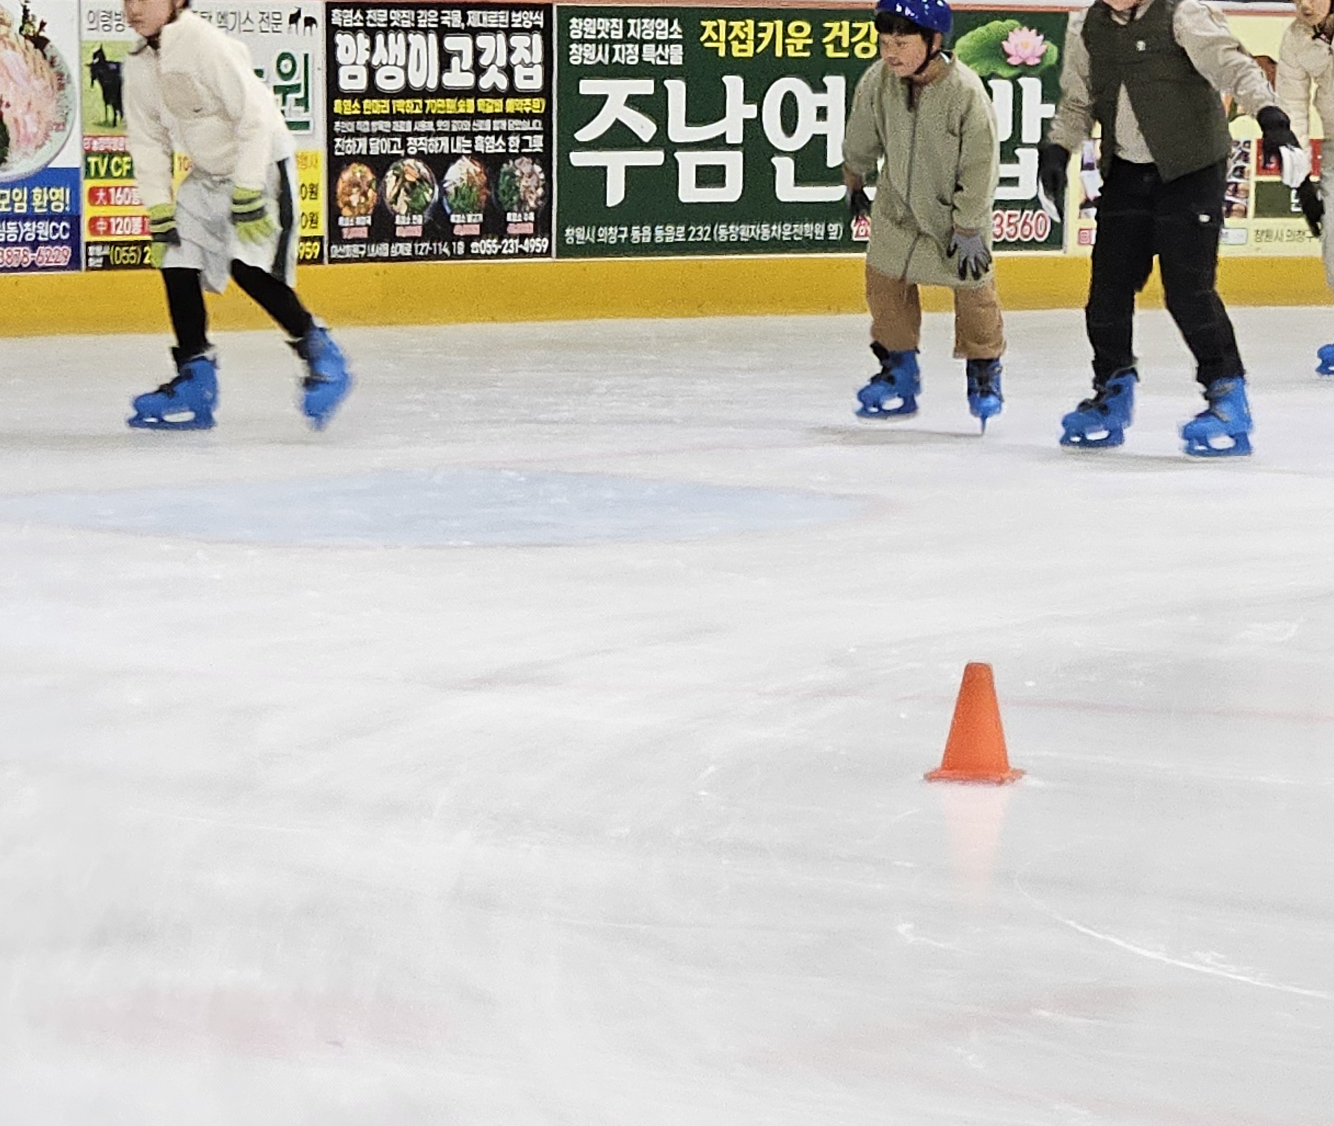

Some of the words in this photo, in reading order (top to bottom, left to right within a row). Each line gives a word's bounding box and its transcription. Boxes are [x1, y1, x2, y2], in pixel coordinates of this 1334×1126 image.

[258, 10, 283, 33] 전문
[331, 8, 365, 28] 흑염소
[366, 8, 388, 28] 전문
[417, 9, 439, 28] 깊은
[511, 9, 544, 29] 보양식
[569, 17, 624, 40] 창원맛집
[627, 17, 684, 40] 지정업소
[700, 20, 813, 58] 직접키운
[569, 43, 609, 65] 창원시
[613, 43, 639, 65] 지정
[642, 42, 684, 65] 특산물
[334, 136, 367, 156] 진하게
[451, 135, 472, 154] 내는
[474, 134, 506, 154] 흑염소
[508, 134, 520, 153] 한
[87, 155, 108, 178] TV
[110, 154, 132, 177] CF
[31, 186, 70, 212] 환영!
[95, 188, 107, 206] 大
[96, 218, 108, 234] 中
[565, 224, 595, 245] 창원시
[597, 224, 628, 244] 의창구
[630, 224, 652, 244] 동읍
[687, 224, 712, 242] 232
[992, 209, 1051, 242] 3560
[109, 244, 142, 265] (055)
[299, 241, 321, 261] 959
